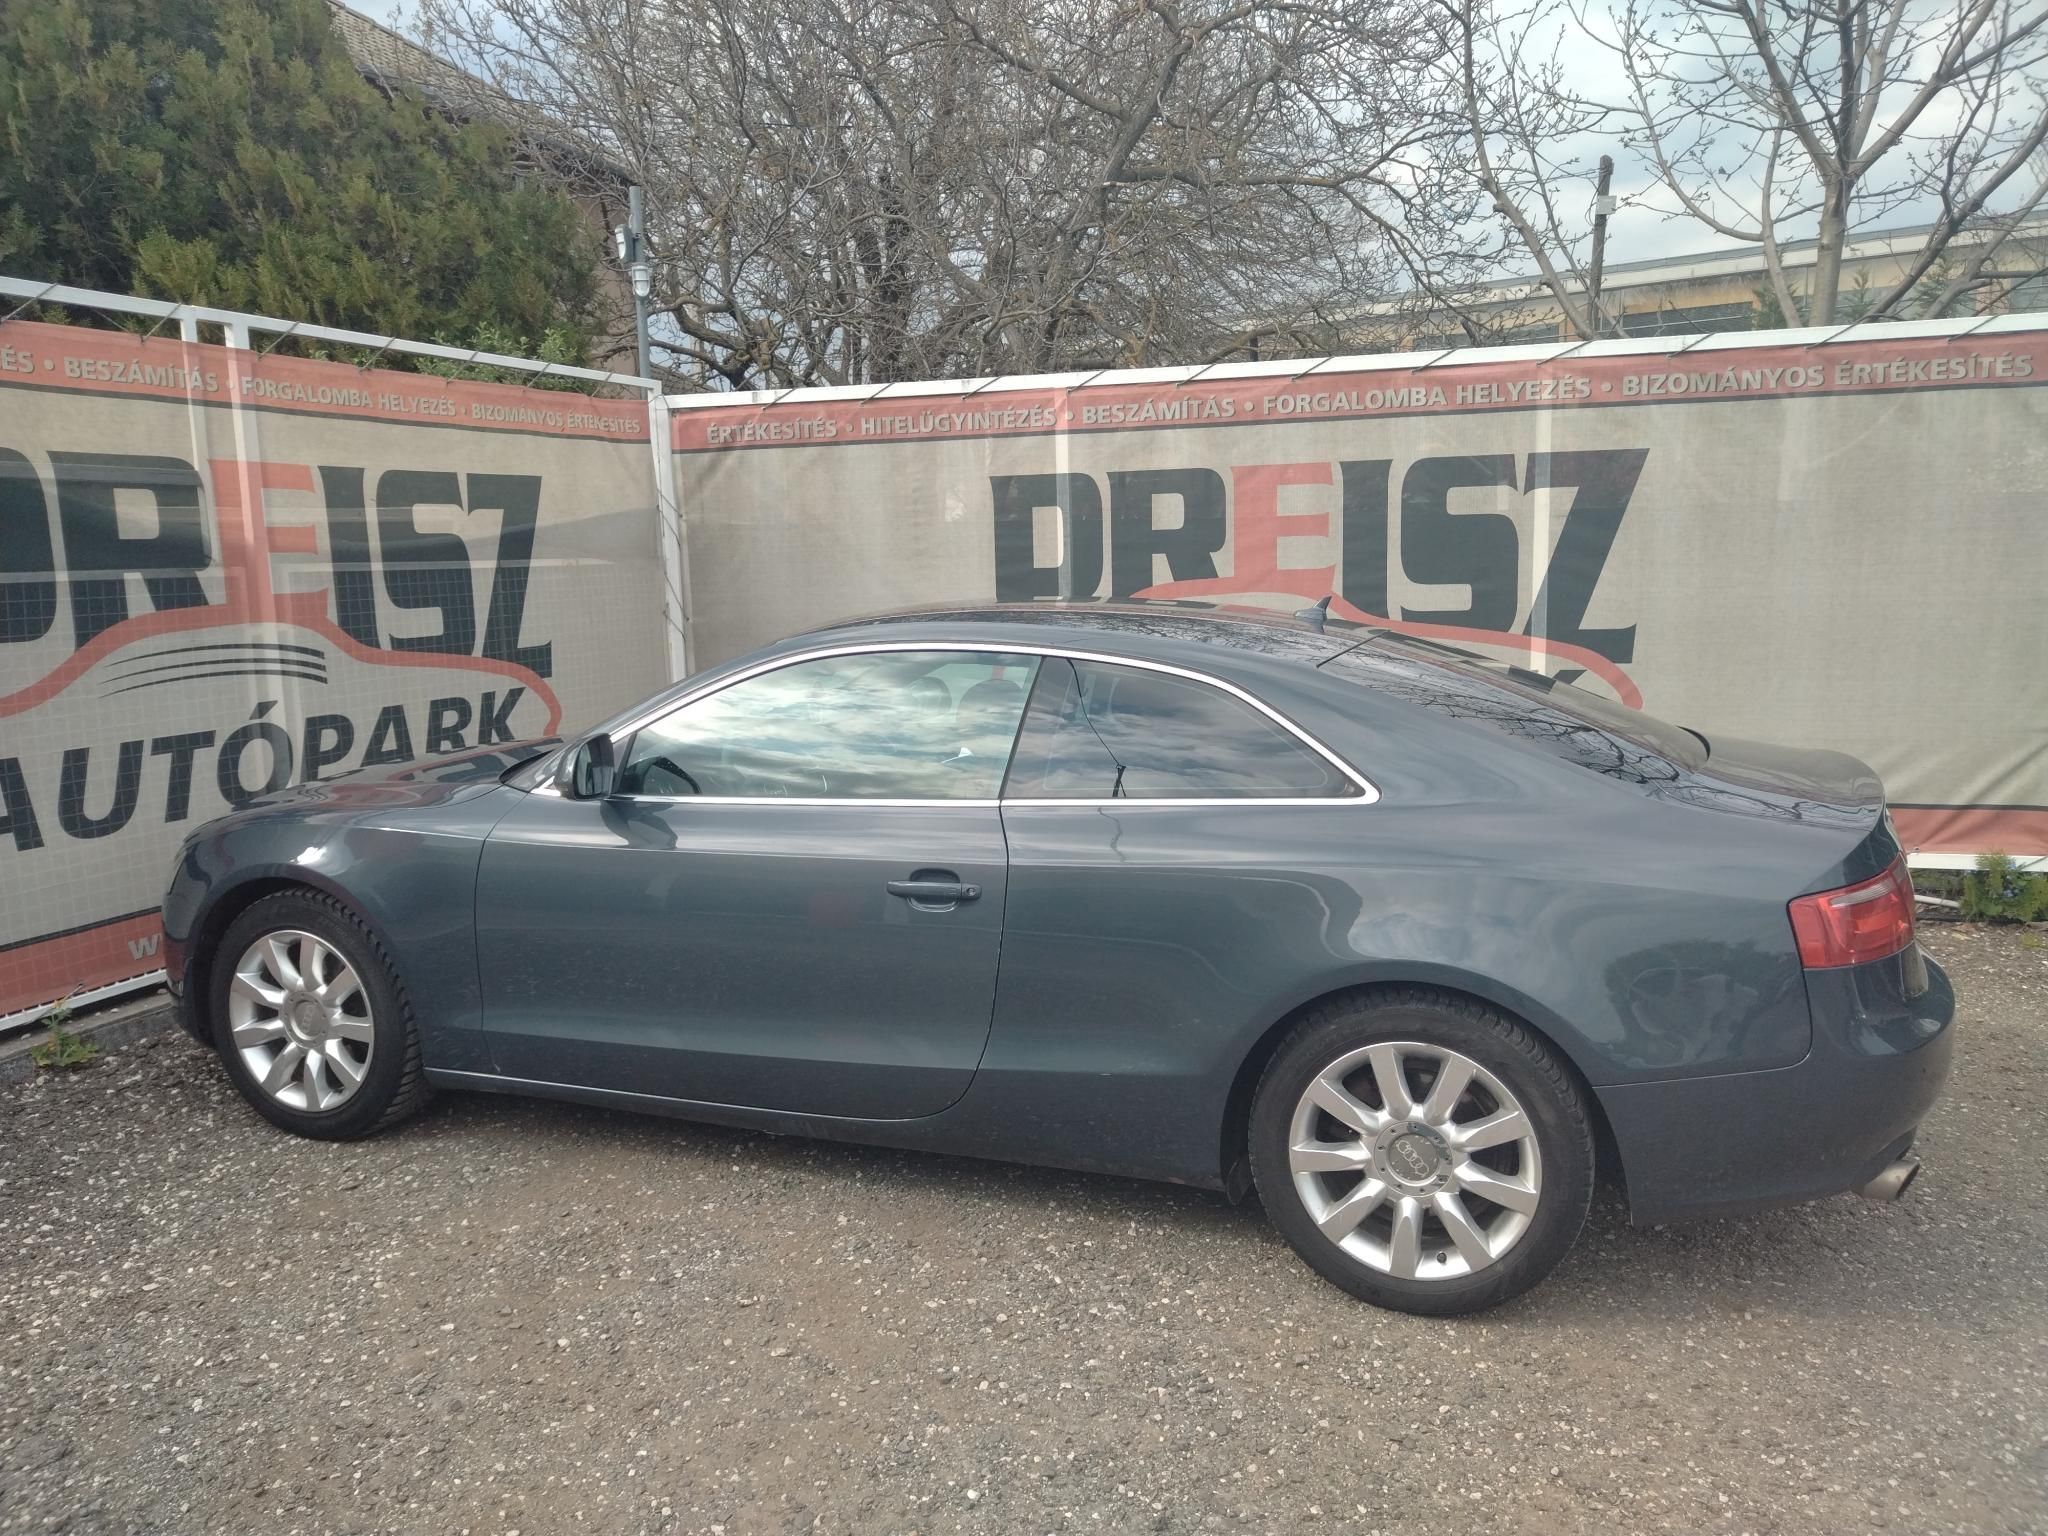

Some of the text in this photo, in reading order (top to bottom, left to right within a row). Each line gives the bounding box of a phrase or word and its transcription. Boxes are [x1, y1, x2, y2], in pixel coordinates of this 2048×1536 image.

[63, 356, 220, 393] BESZÁMÍTÁS
[241, 376, 374, 408] FORGALOMBA
[378, 392, 457, 417] HELYEZÉS
[472, 403, 564, 428] BIZOMÁNYOS
[707, 352, 2034, 445] ÉRTÉKESÍTÉS HITELÜGYINTÉZÉS BESZÁMÍTÁS FORGALOMBA HELYEZÉS BIZOMÁNYOS ÉRTÉKESÍTÉS
[989, 448, 1650, 664] DREISZ
